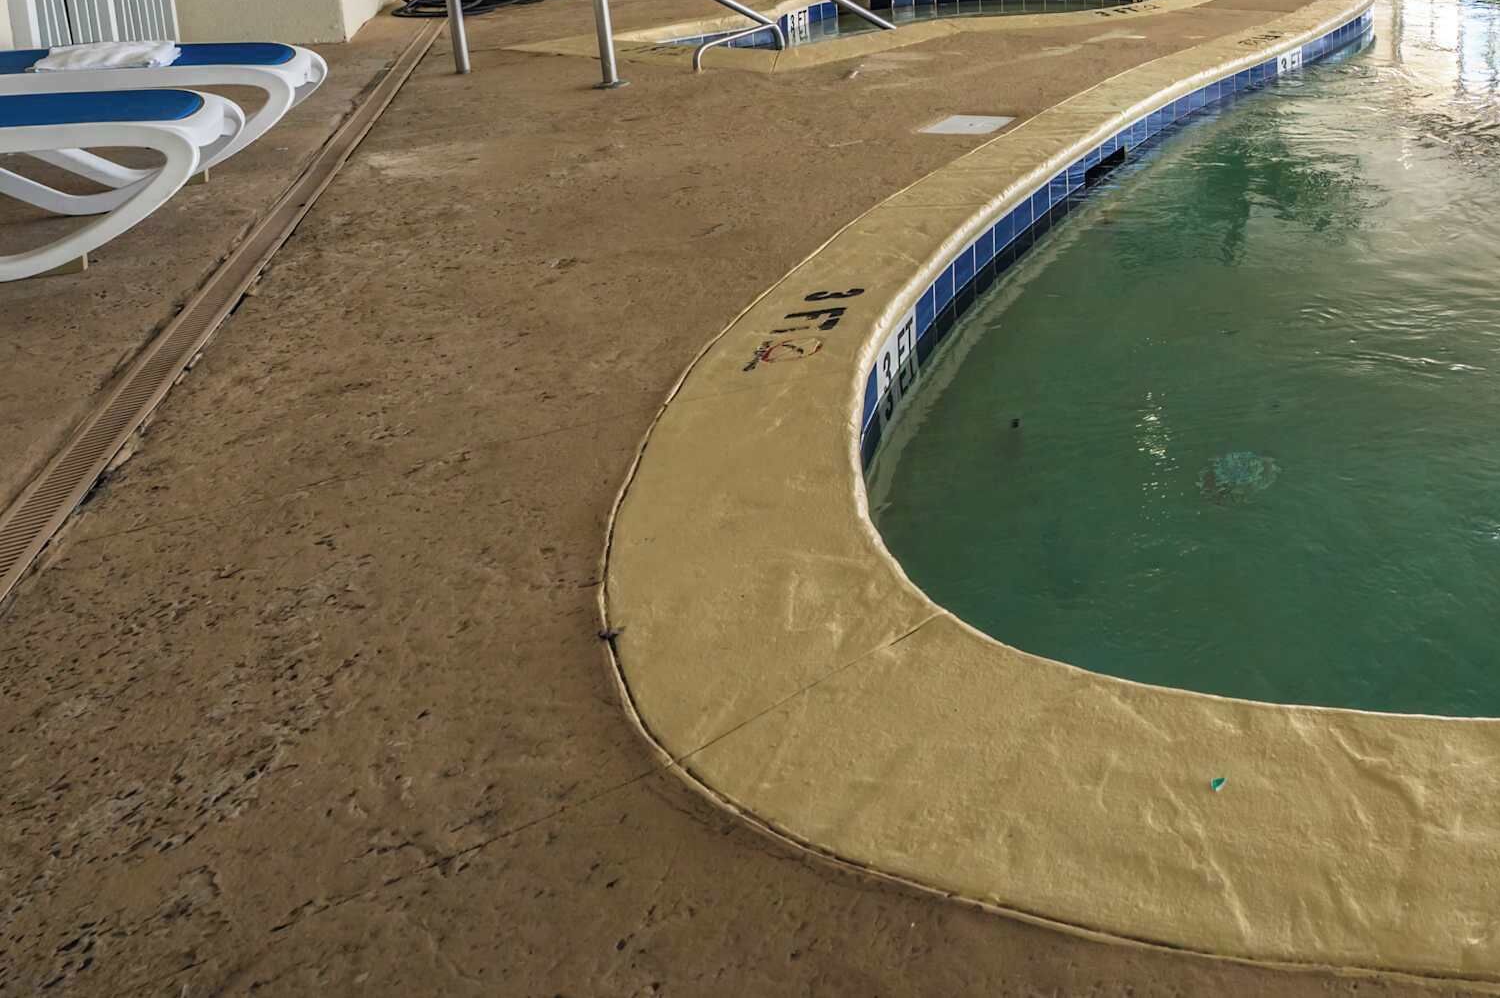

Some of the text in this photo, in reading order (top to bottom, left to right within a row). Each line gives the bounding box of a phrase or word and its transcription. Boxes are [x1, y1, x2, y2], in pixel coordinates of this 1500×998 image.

[804, 288, 865, 302] 3
[882, 316, 914, 393] 3 FT
